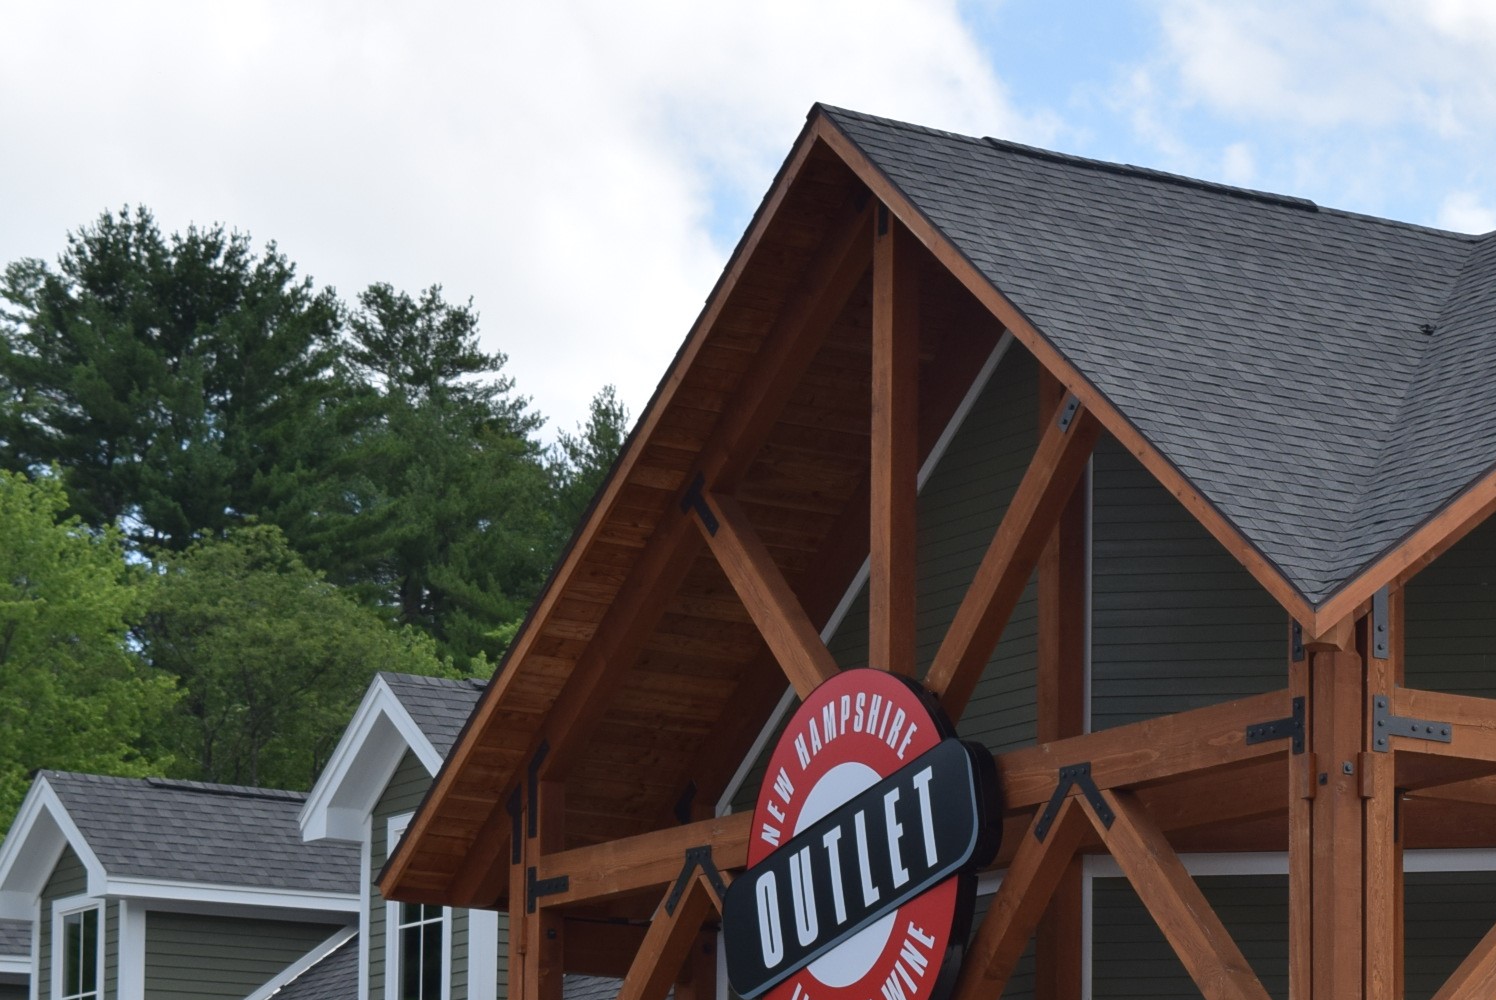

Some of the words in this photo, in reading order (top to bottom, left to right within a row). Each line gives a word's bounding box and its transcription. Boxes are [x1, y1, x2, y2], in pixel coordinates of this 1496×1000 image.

[760, 766, 796, 847] NEW
[793, 692, 918, 770] HAMPSHIRE
[755, 765, 939, 969] OUTLET
